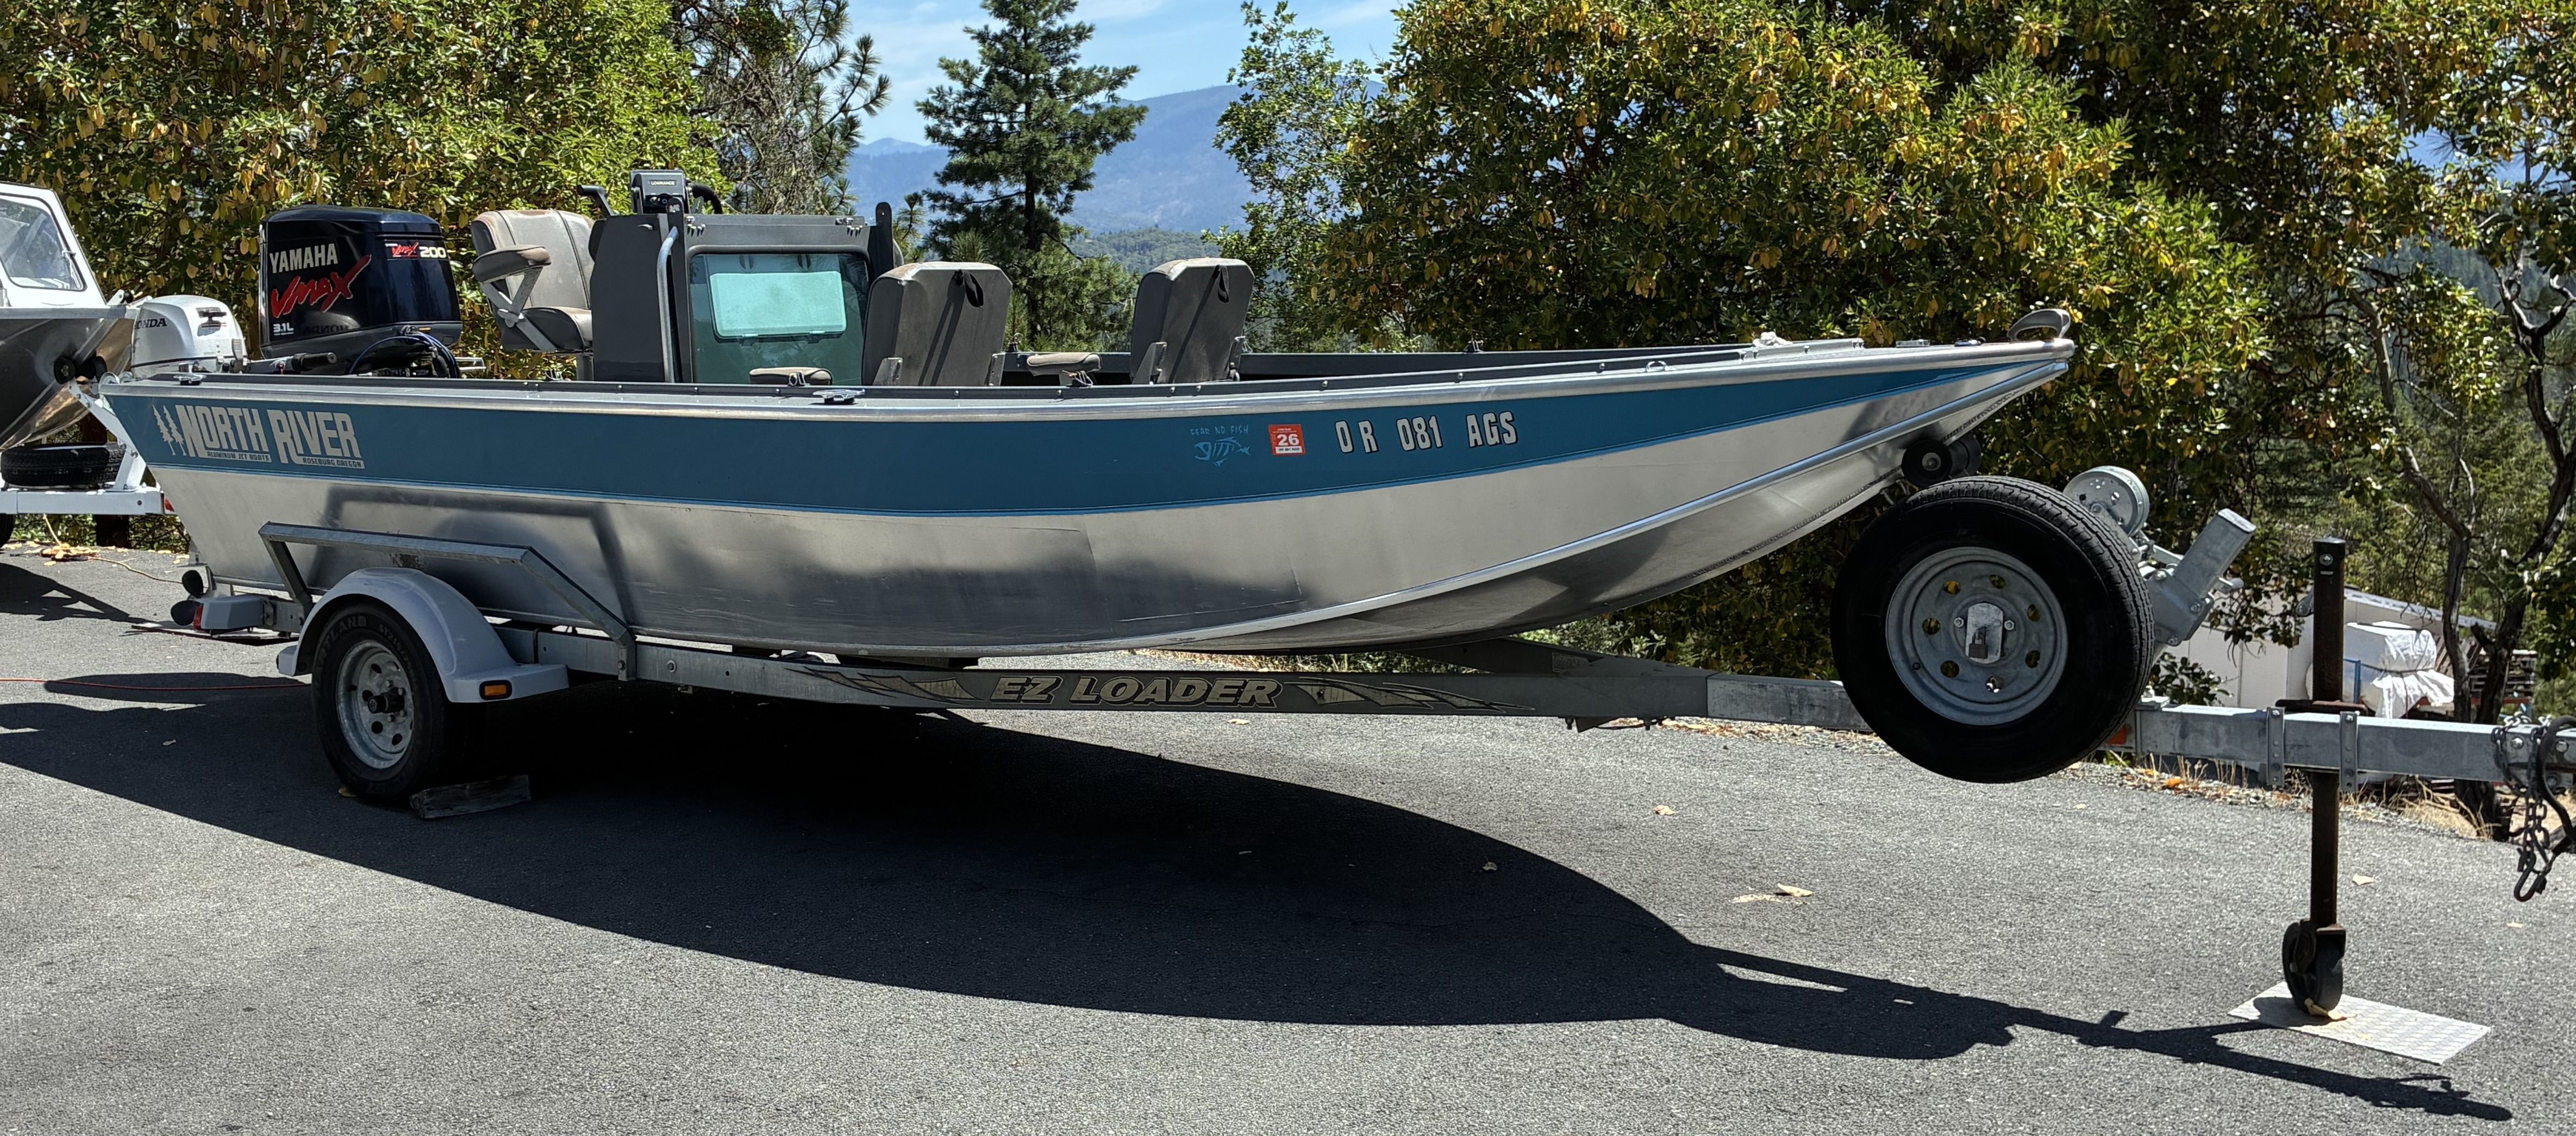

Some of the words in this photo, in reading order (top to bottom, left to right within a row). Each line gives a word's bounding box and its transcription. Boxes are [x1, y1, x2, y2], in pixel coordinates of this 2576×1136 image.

[419, 246, 446, 258] 200
[270, 244, 338, 273] YAMAHA
[273, 322, 294, 332] 3.1L
[175, 405, 269, 457] NORTH
[266, 409, 362, 464] RIVER
[1230, 425, 1249, 434] FISH
[1396, 415, 1443, 452] 081
[1466, 411, 1517, 448] AGS
[1277, 434, 1299, 446] 26
[336, 459, 361, 467] OREGON
[990, 676, 1063, 704] EZ
[1069, 676, 1282, 708] LOADER
